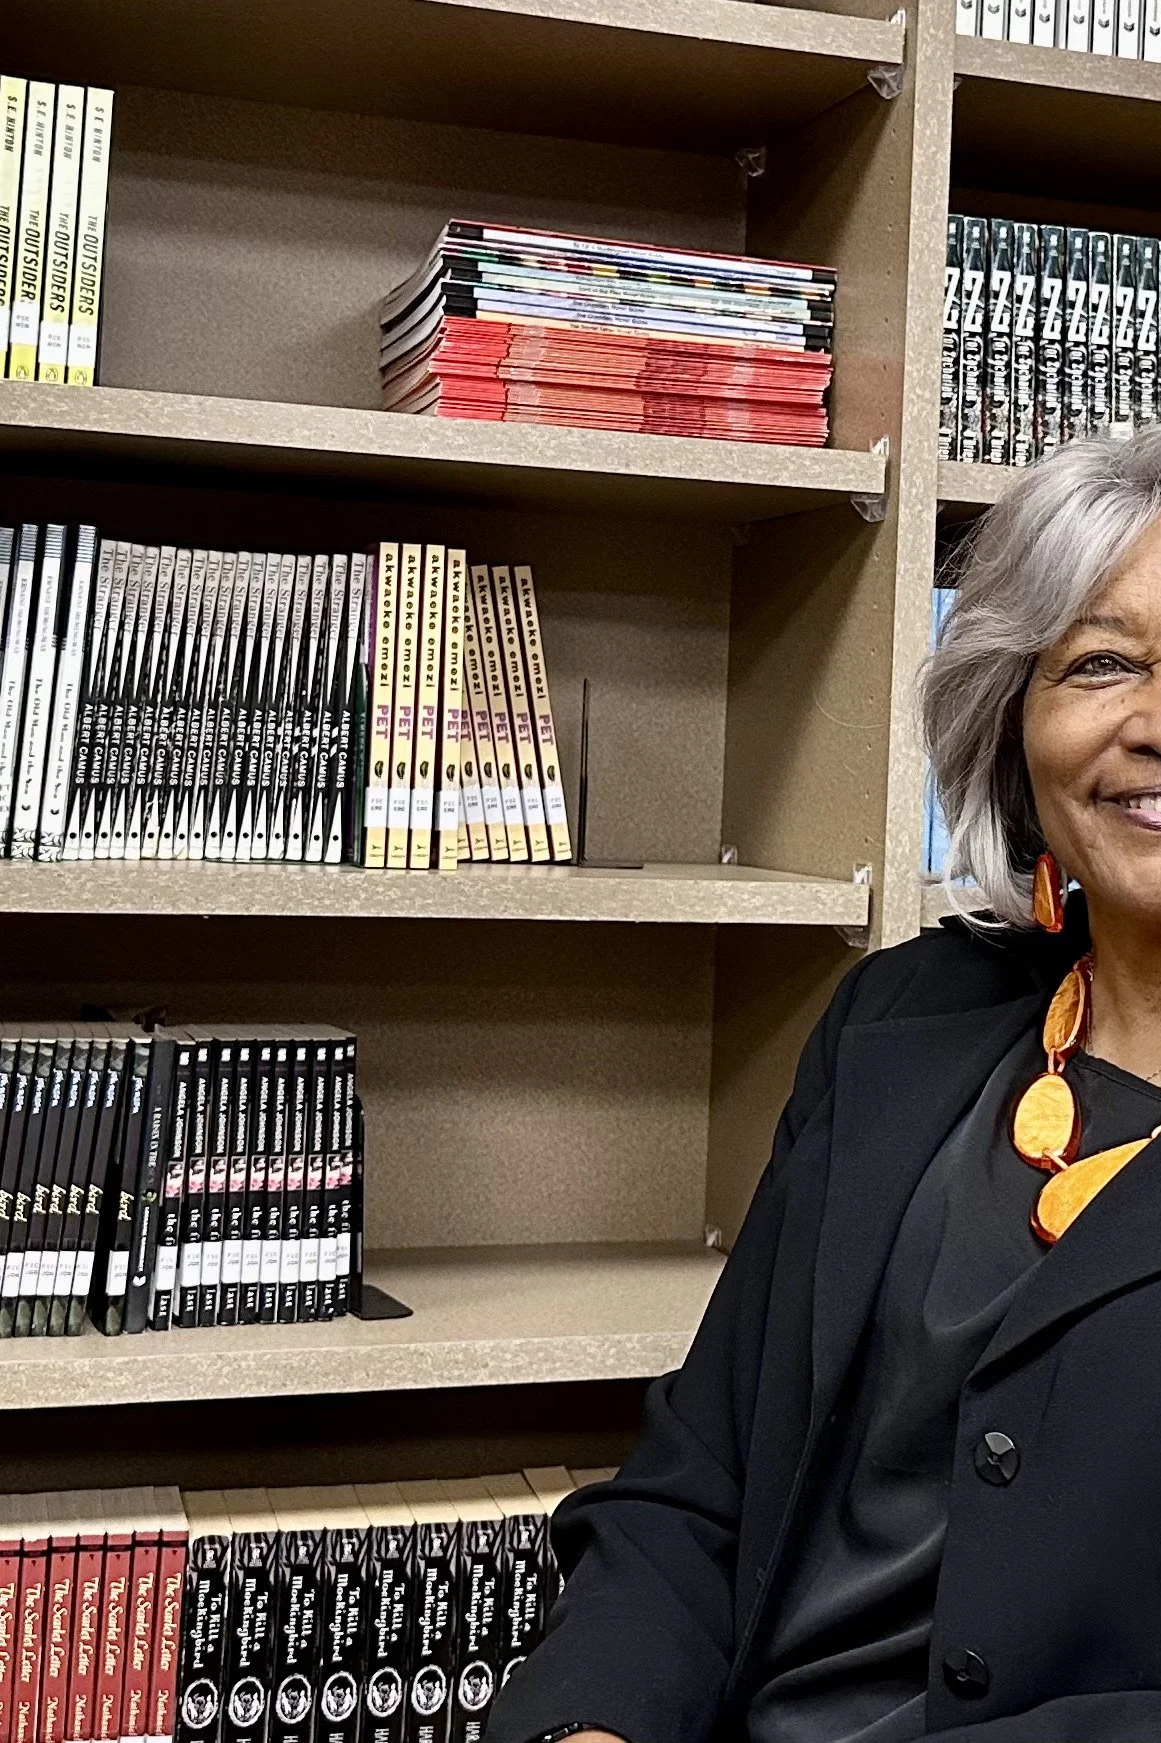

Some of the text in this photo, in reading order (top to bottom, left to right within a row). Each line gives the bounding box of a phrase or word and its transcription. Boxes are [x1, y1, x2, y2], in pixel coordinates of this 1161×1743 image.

[5, 116, 16, 152] HINTON
[34, 122, 44, 156] HINTON
[64, 124, 74, 160] HINTON
[92, 128, 102, 162] HINTON
[20, 209, 40, 302] THE OUTSIDER
[50, 212, 70, 313] THE OUTSIDERS
[78, 216, 99, 316] THE OUTSIDERS
[964, 270, 984, 332] Z
[991, 270, 1012, 332] Z
[1016, 274, 1036, 338] Z
[1043, 278, 1062, 340] Z
[1116, 286, 1134, 348] Z
[154, 554, 173, 634] The Stranger
[186, 557, 205, 638] The Stranger
[200, 560, 220, 639] The Stranger
[247, 561, 264, 640] The Stranger
[276, 562, 292, 640] The Stranger
[380, 553, 394, 687] akwaeke emezi
[403, 554, 417, 688] akwaeke emezi
[426, 554, 440, 688] akwaeke emezi
[450, 560, 462, 691] akwaeke emezi
[477, 575, 502, 696] akwaeke emezi
[499, 576, 524, 697] akwaeke emezi
[521, 578, 546, 699] akwaeke emezi
[468, 649, 482, 695] emezi
[107, 705, 123, 784] ALBERT CAMUS
[121, 705, 138, 784] ALBERT CAMUS
[137, 706, 154, 784] ALBERT CAMUS
[336, 710, 350, 788] ALBERT CAMUS
[376, 704, 389, 740] PET
[398, 706, 412, 740] PET
[421, 705, 434, 740] PET
[447, 708, 460, 743] PET
[476, 710, 491, 742] PET
[495, 712, 510, 744] PET
[517, 712, 531, 744] PET
[540, 714, 554, 745] PET
[32, 1184, 50, 1214] bird
[49, 1184, 66, 1214] bird
[67, 1184, 84, 1214] bird
[86, 1184, 103, 1214] bird
[166, 1213, 177, 1233] the
[251, 1206, 262, 1226] the
[159, 1295, 170, 1316] last
[226, 1288, 237, 1309] last
[50, 1578, 70, 1678] The Scarlet Letter
[78, 1576, 99, 1676] The Scarlet Letter
[133, 1572, 154, 1670] The Scarlet Letter
[161, 1572, 182, 1671] The Scarlet Letter
[190, 1580, 210, 1668] Mockingbird
[207, 1593, 222, 1653] To Kill a
[236, 1578, 256, 1668] Mockingbird
[253, 1592, 268, 1652] To Kill a
[329, 1574, 348, 1662] Mockingbird
[346, 1586, 360, 1646] To Kill a
[419, 1568, 438, 1656] Mockingbird
[434, 1581, 450, 1640] To Kill a
